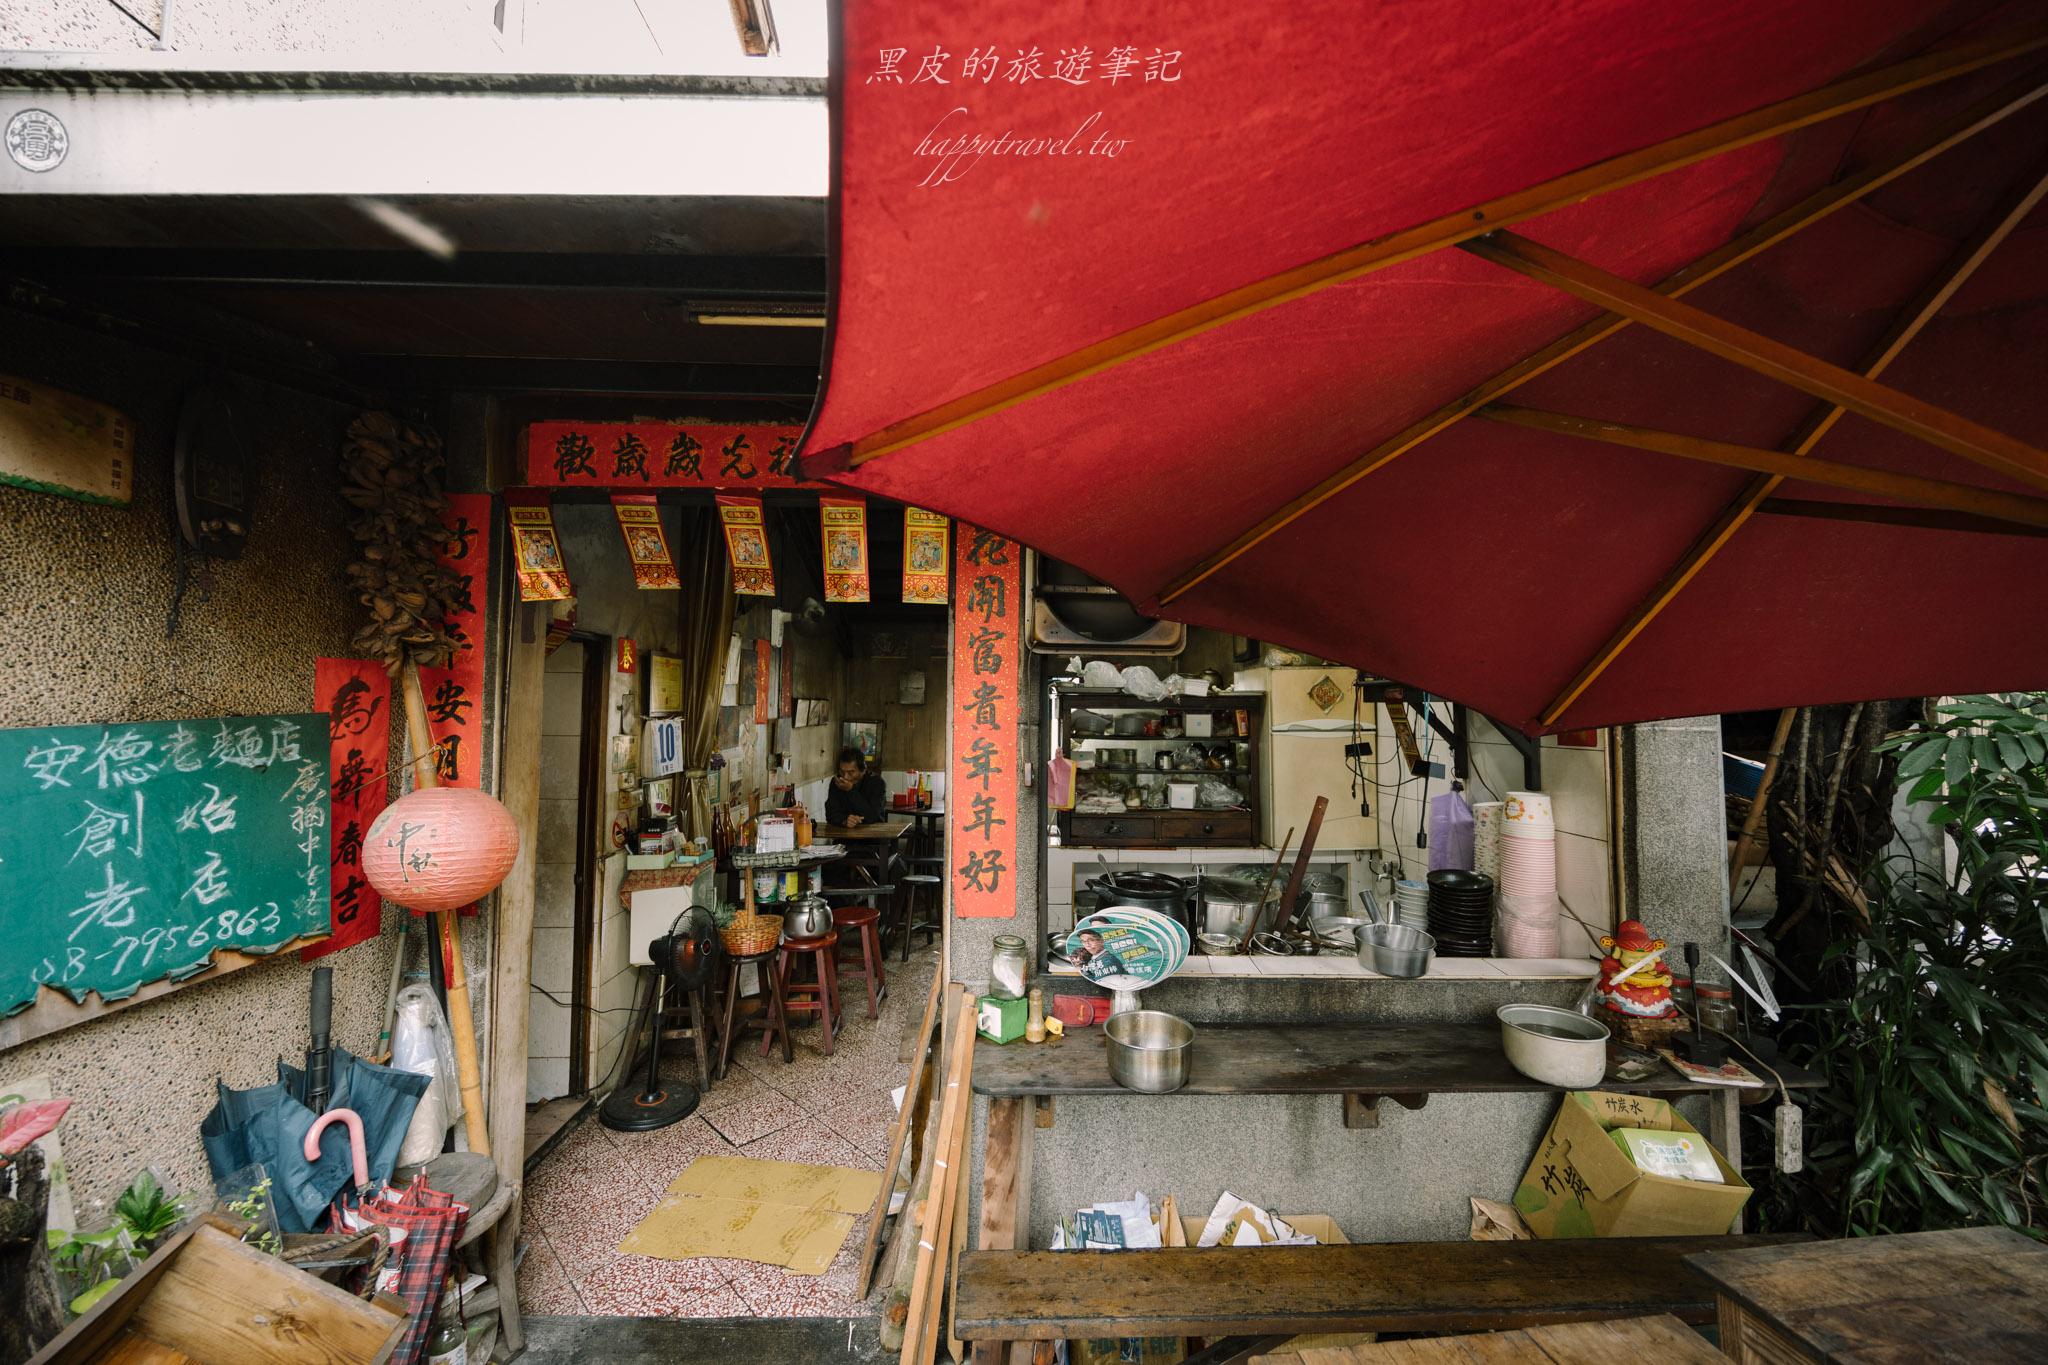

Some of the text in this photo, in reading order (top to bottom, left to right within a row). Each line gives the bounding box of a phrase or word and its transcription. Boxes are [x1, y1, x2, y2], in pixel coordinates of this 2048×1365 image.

[958, 530, 1009, 894] 花開富貴年年好
[658, 723, 675, 763] 10
[1605, 1097, 1644, 1115] 竹炭水
